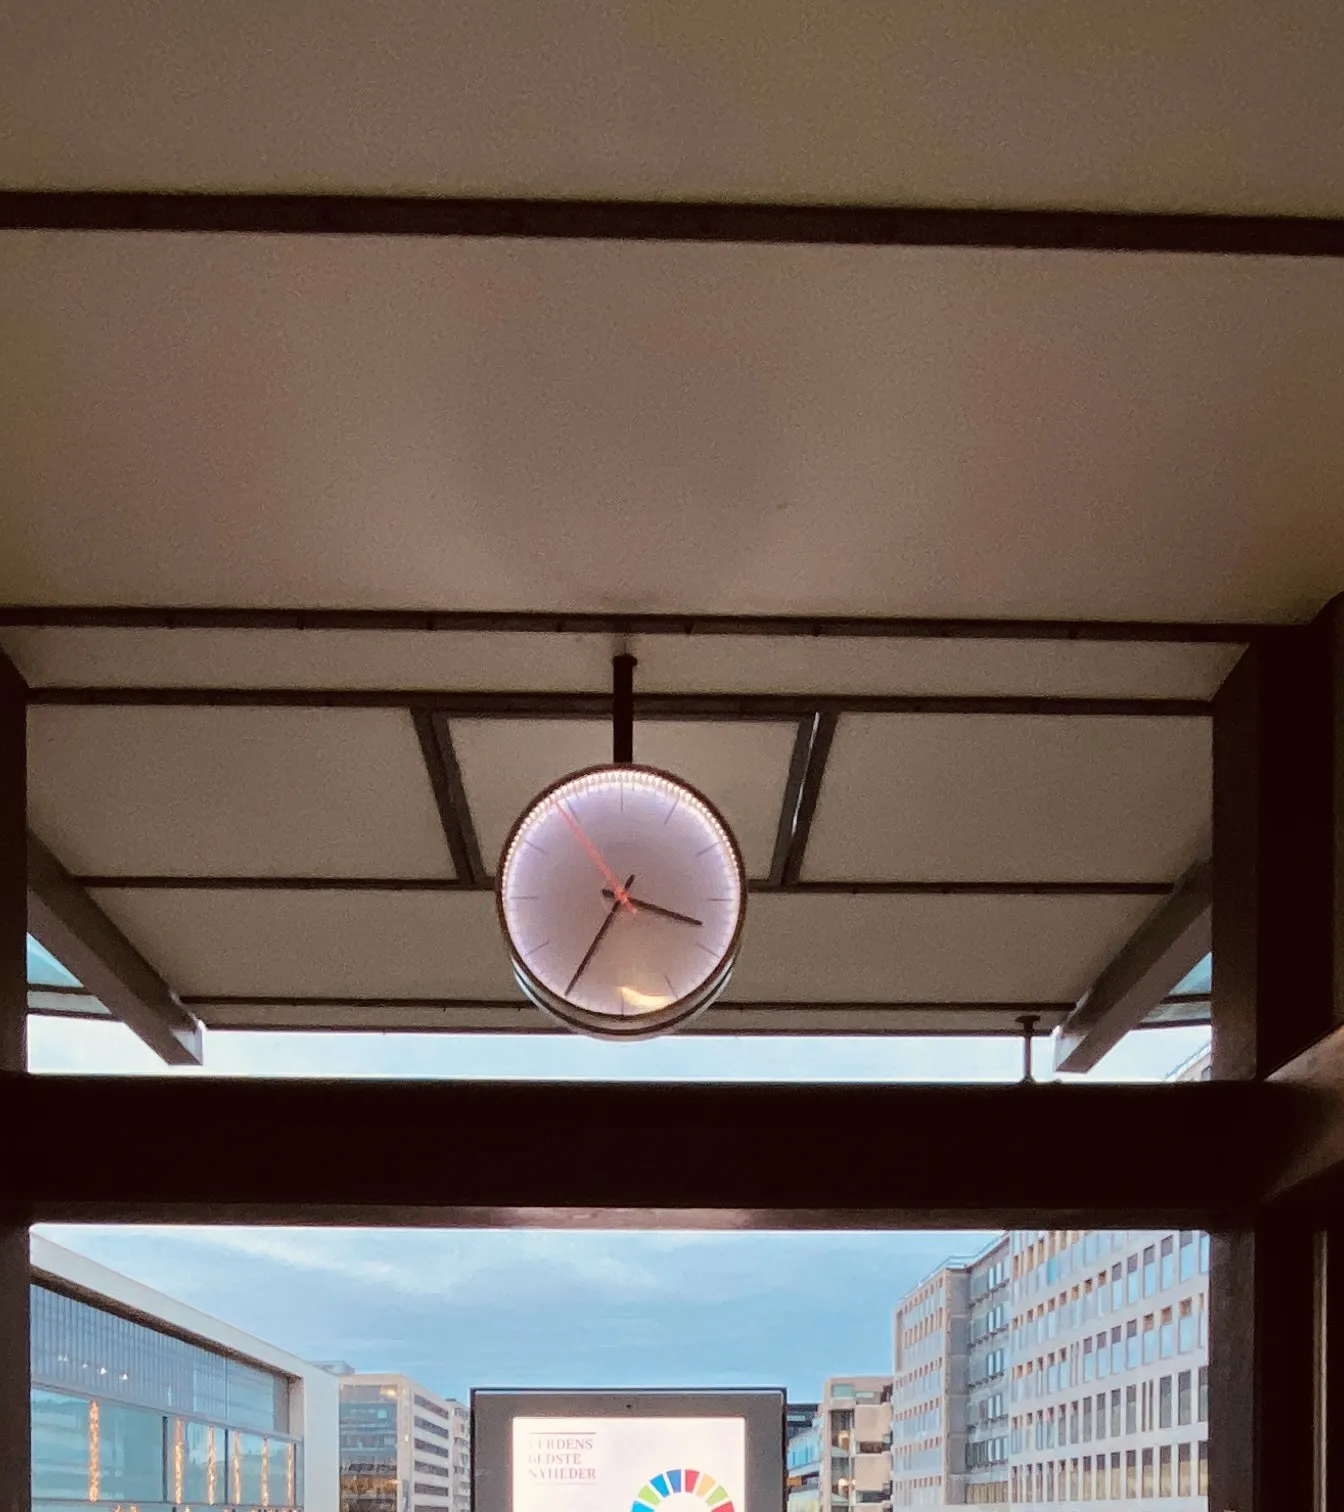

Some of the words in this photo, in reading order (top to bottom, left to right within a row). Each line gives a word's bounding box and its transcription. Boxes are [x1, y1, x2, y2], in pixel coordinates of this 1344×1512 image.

[528, 1439, 593, 1450] VERDENS
[528, 1453, 582, 1464] BEDSTE
[528, 1468, 596, 1479] NYHEDER
